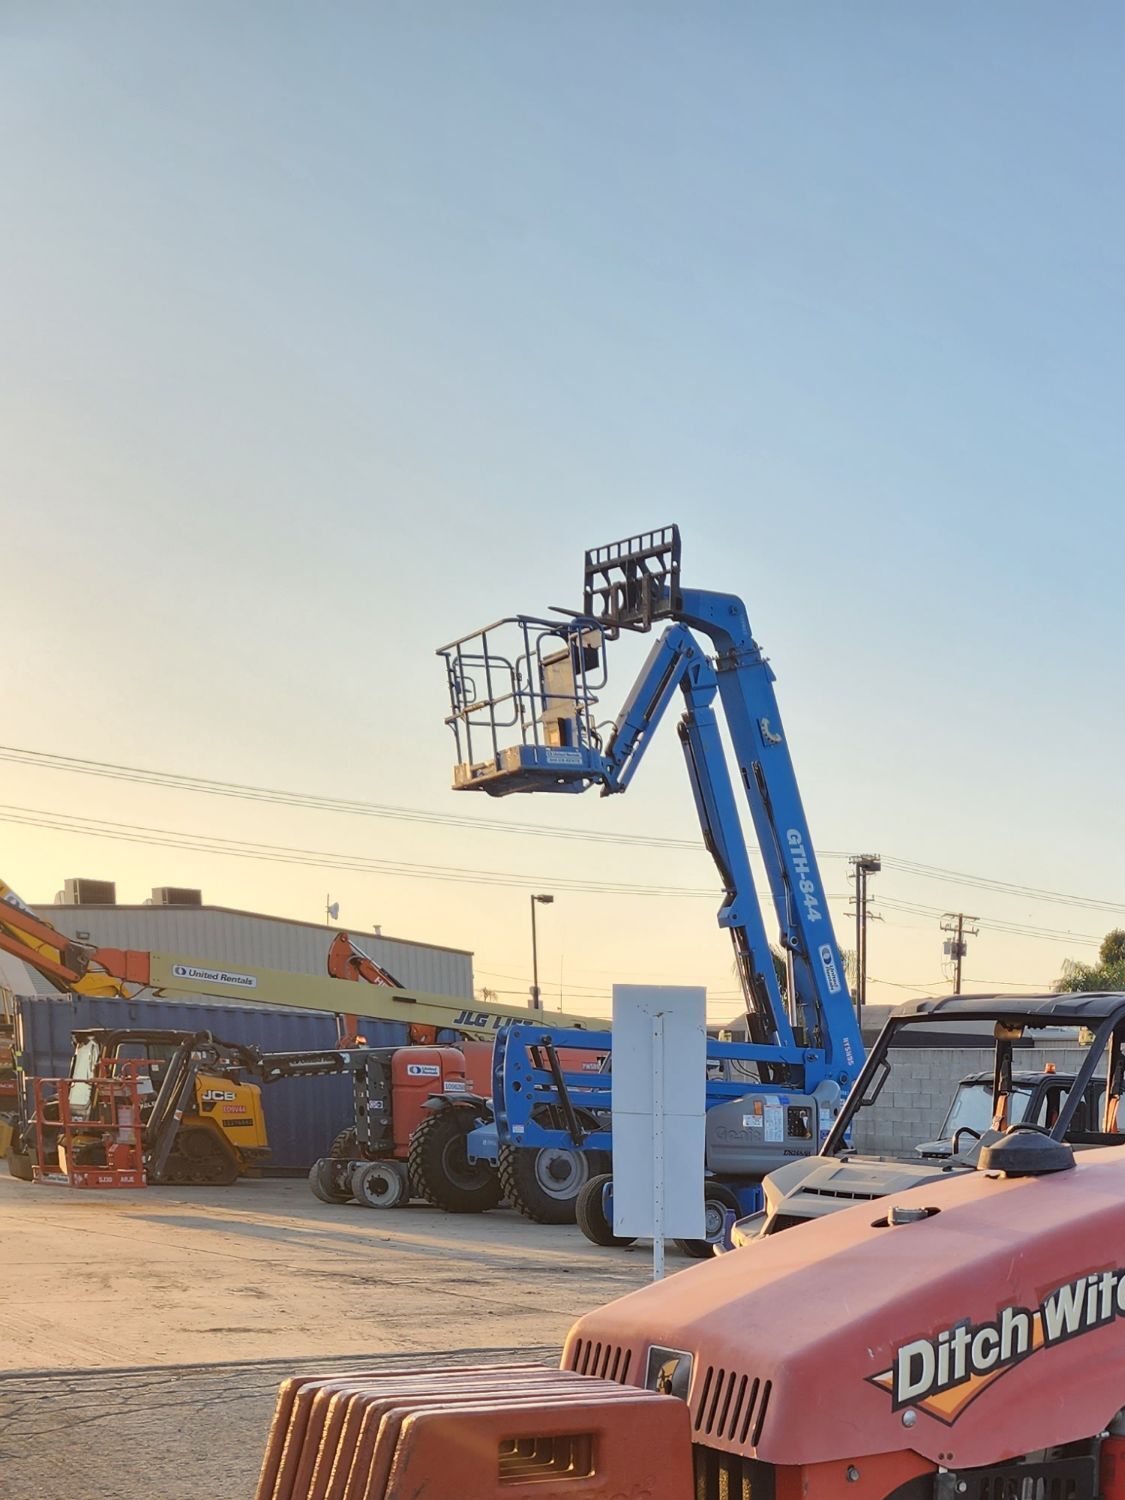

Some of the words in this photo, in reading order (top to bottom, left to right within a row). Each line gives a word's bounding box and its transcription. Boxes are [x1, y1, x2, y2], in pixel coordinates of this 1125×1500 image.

[787, 829, 822, 922] GTH-844
[188, 968, 219, 980] United
[220, 973, 253, 985] Rentals
[453, 1010, 489, 1028] JLG
[202, 1090, 235, 1101] JCB
[898, 1307, 1031, 1403] Ditch
